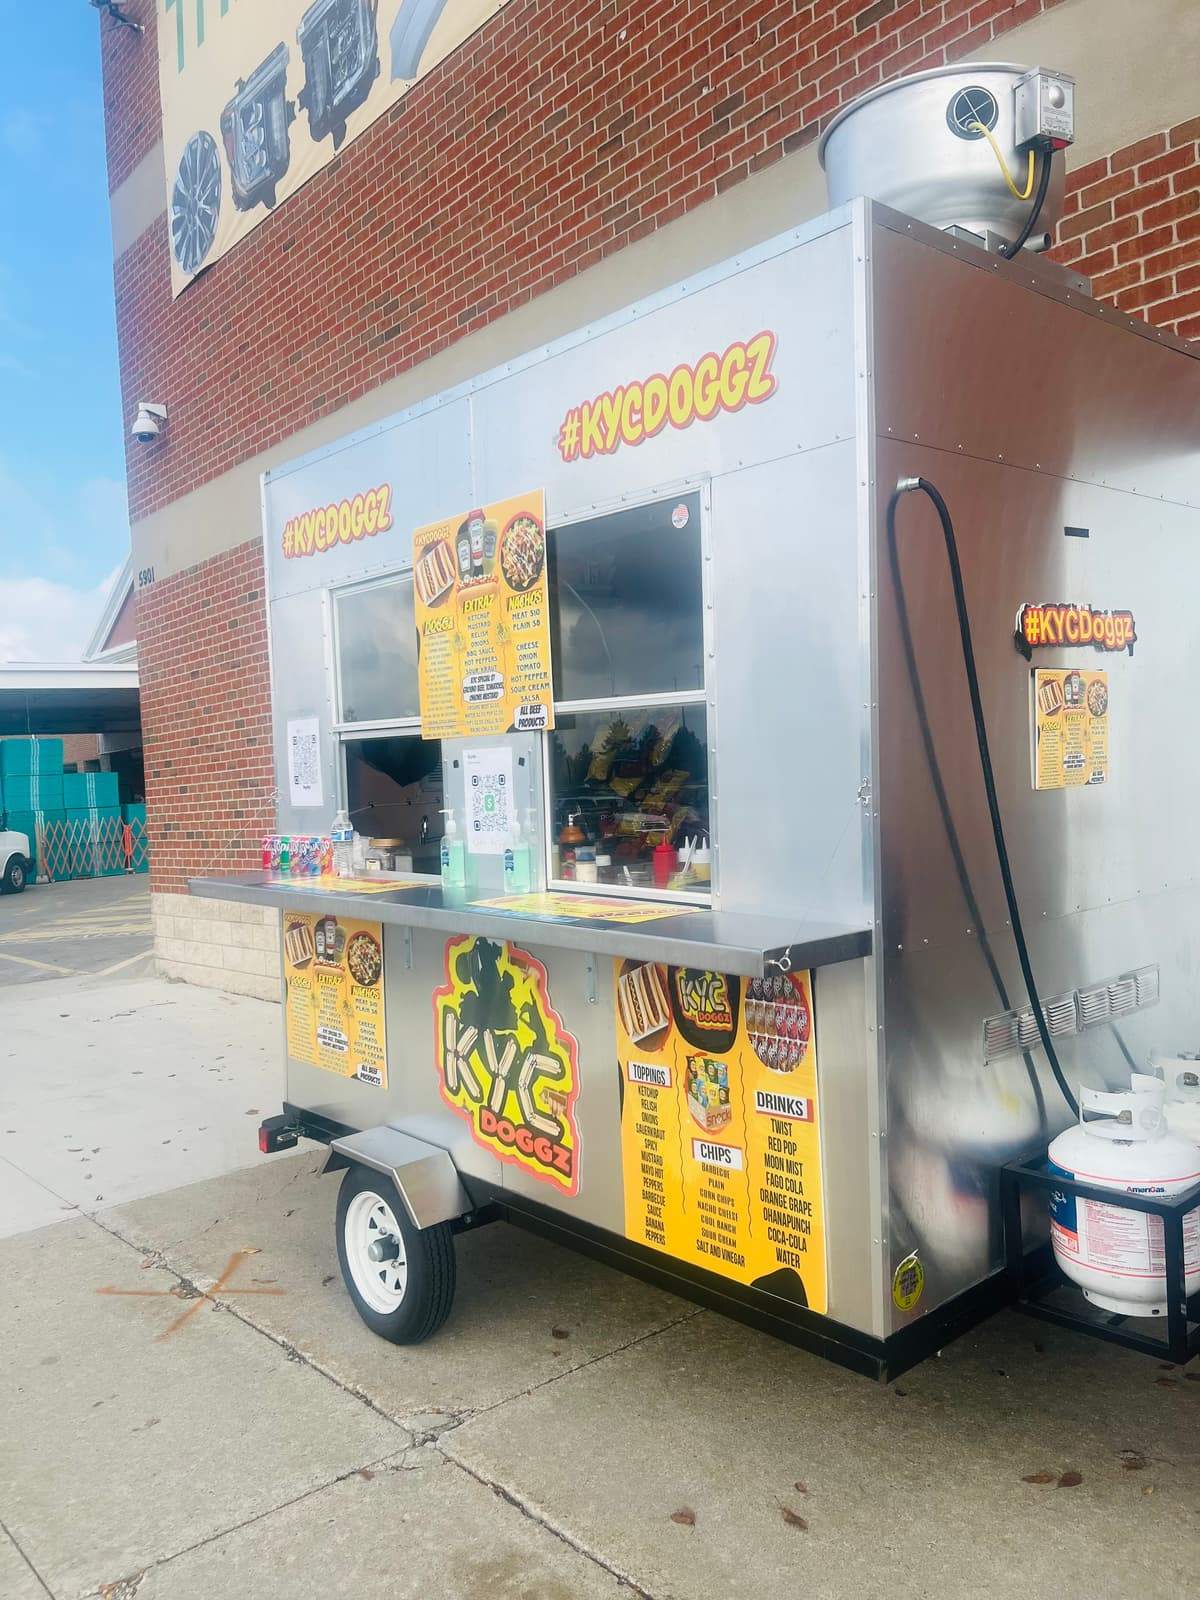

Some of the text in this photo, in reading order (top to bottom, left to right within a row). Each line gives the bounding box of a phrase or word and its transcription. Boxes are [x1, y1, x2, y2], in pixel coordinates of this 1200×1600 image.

[561, 334, 774, 461] #KYCDOGGZ
[284, 485, 391, 558] #KYCDOGGZ
[138, 565, 155, 587] 5901
[463, 594, 495, 613] EXTRAZ
[507, 590, 542, 612] NACHOS
[512, 611, 528, 620] MEAT
[513, 622, 531, 631] PLAIN
[1025, 609, 1134, 646] #KYCDoggz
[516, 641, 539, 651] CHEESE
[519, 652, 537, 661] ONION
[517, 662, 541, 672] TOMATO
[511, 671, 547, 683] HOT PEPPER
[511, 682, 550, 694] SOUR CREAM
[520, 693, 540, 703] SALSA
[520, 704, 542, 716] ALL BEEF
[518, 716, 545, 728] PRODUCTS
[351, 986, 380, 999] NACHOS
[680, 978, 725, 1012] KYC
[698, 1012, 731, 1023] DOGGZ
[445, 1012, 562, 1137] KYC
[632, 1063, 666, 1085] TOPPINGS
[638, 1086, 659, 1100] KETCHUP
[641, 1098, 658, 1113] RELISH
[757, 1091, 803, 1117] DRINKS
[641, 1111, 659, 1126] ONIONS
[770, 1118, 792, 1137] TWIST
[636, 1122, 665, 1140] SAUERKRAUT
[481, 1109, 572, 1172] DOGGZ
[644, 1138, 658, 1152] SPICY
[768, 1136, 797, 1157] RED POP
[641, 1150, 663, 1166] MUSTARD
[700, 1143, 732, 1164] CHIPS
[641, 1163, 664, 1180] MAYO HOT
[701, 1161, 730, 1179] BARBECUE
[764, 1153, 804, 1177] MOON MIST
[643, 1176, 664, 1192] PEPPERS
[708, 1177, 725, 1191] PLAIN
[766, 1171, 804, 1196] FAGO COLA
[642, 1189, 666, 1207] BARBECUE
[699, 1188, 735, 1208] CORN CHIPS
[760, 1188, 812, 1217] ORANGE GRAPE
[647, 1203, 662, 1218] SAUCE
[697, 1200, 738, 1222] NACHO CHEESE
[645, 1215, 665, 1232] BANANA
[700, 1214, 737, 1235] COOL RANCH
[763, 1207, 811, 1235] OHANAPUNCH
[645, 1228, 666, 1246] PEPPERS
[701, 1227, 737, 1249] SOUR CREAM
[767, 1226, 807, 1253] COCA-COLA
[696, 1239, 746, 1268] SALT AND VINEGAR
[775, 1246, 801, 1269] WATER
